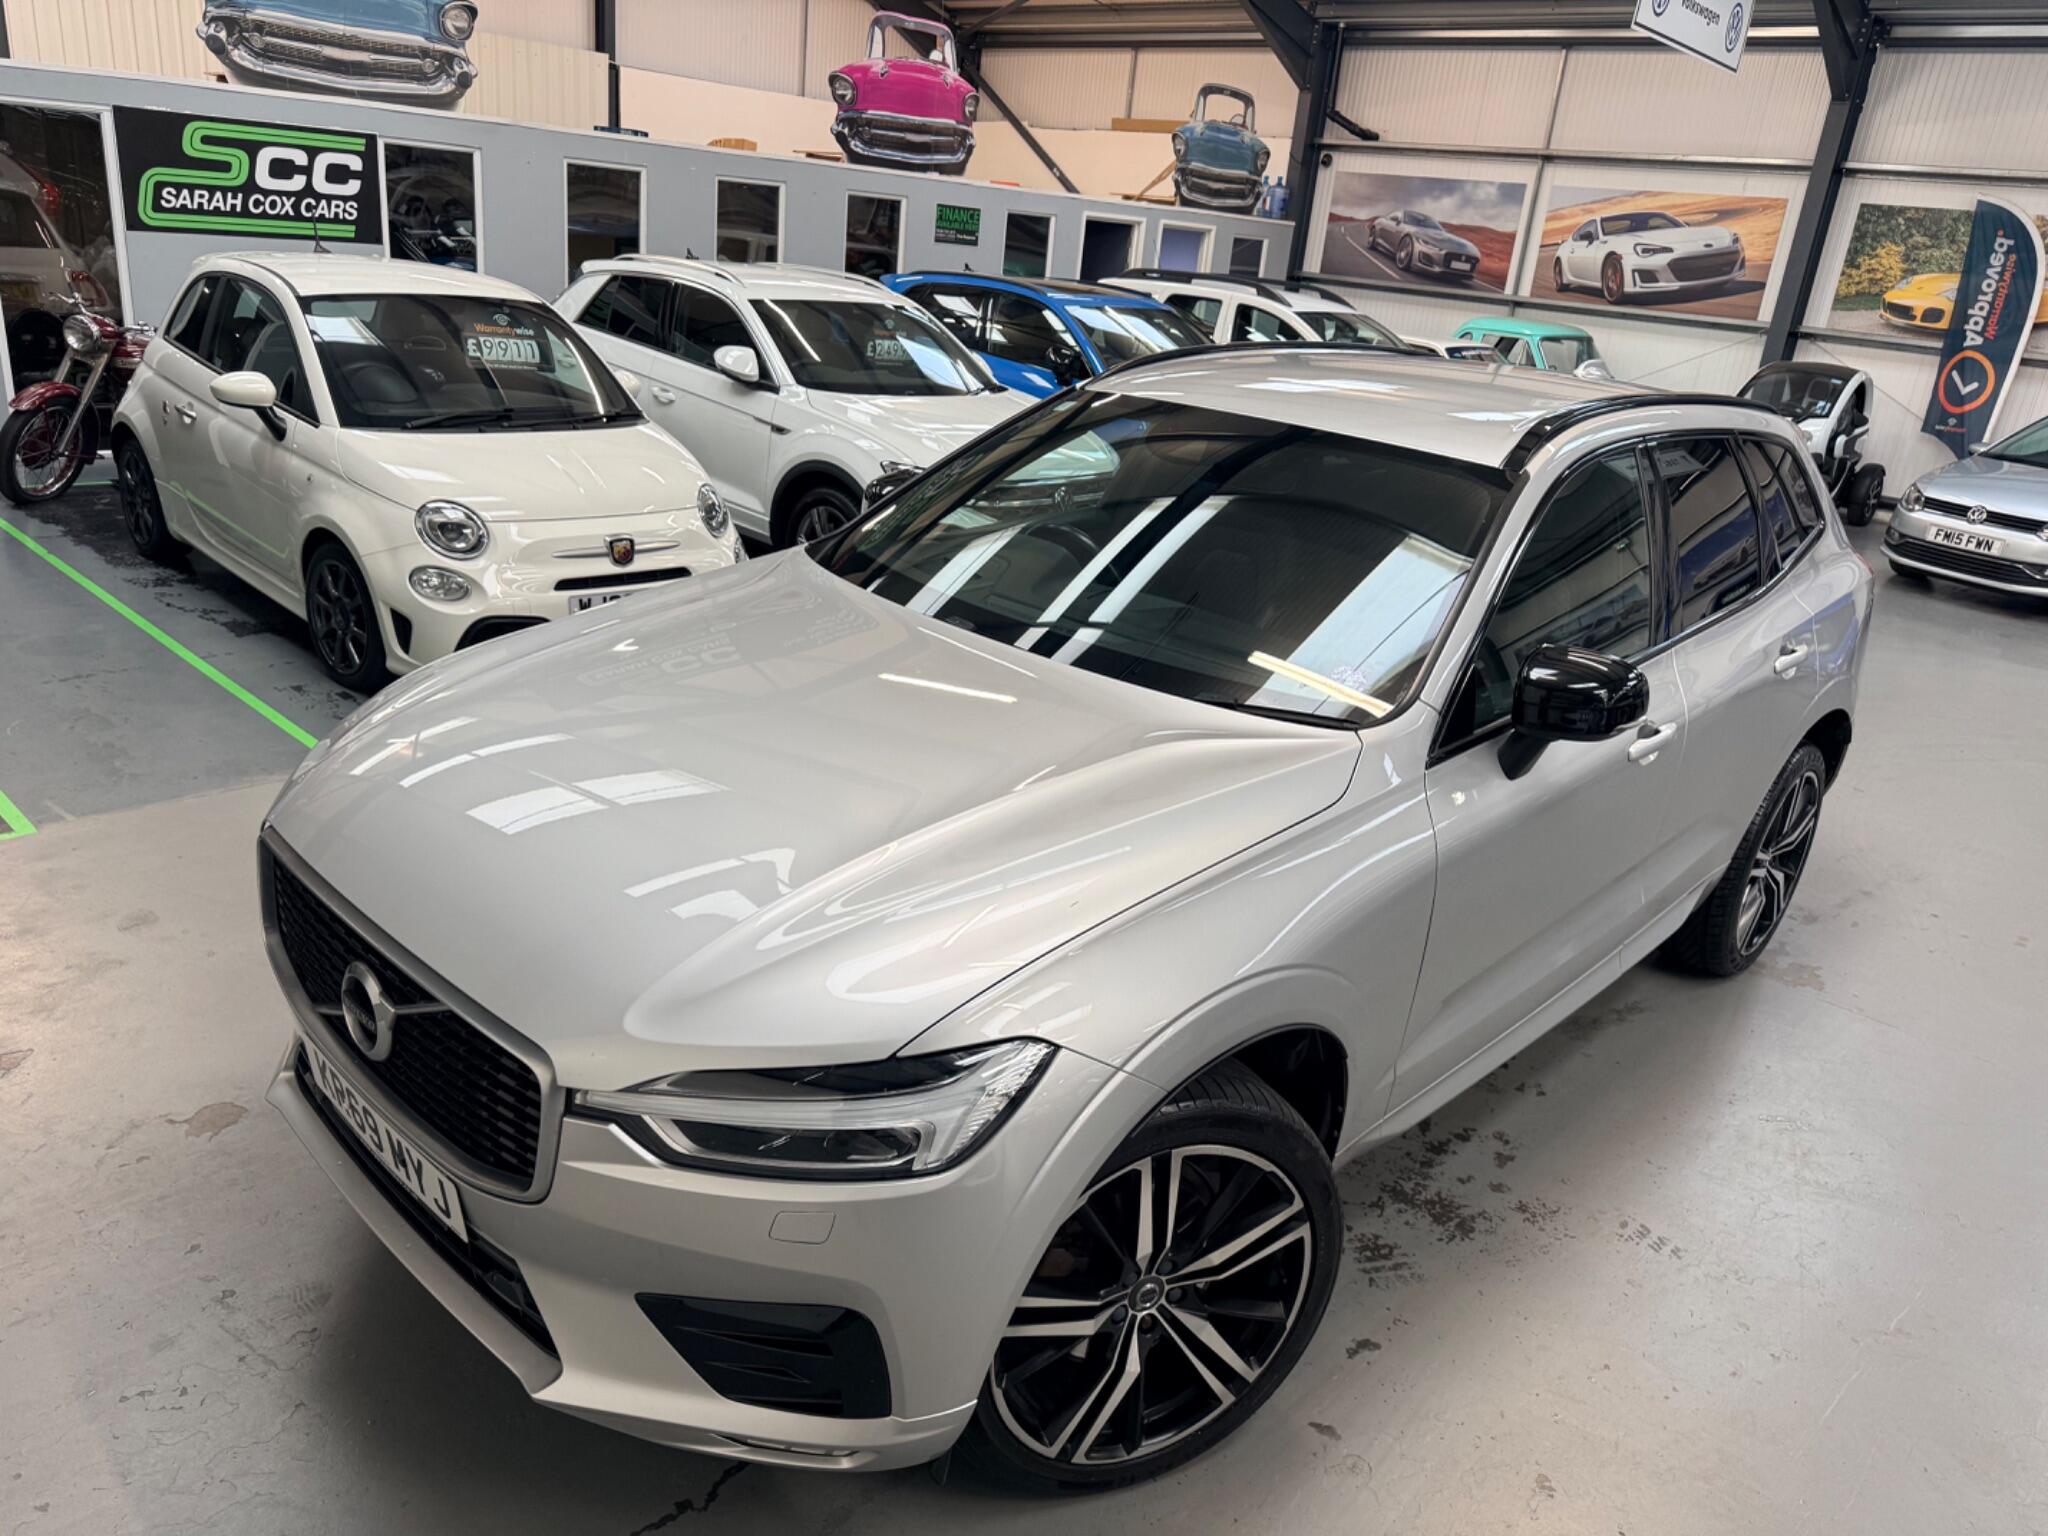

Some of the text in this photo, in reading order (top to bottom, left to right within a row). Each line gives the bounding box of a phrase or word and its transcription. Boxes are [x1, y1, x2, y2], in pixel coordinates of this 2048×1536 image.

[160, 187, 358, 220] SARAH COX CARS
[937, 207, 980, 223] FINANCE
[474, 322, 535, 337] Warrantywise
[1934, 528, 1994, 552] FM15 FWN
